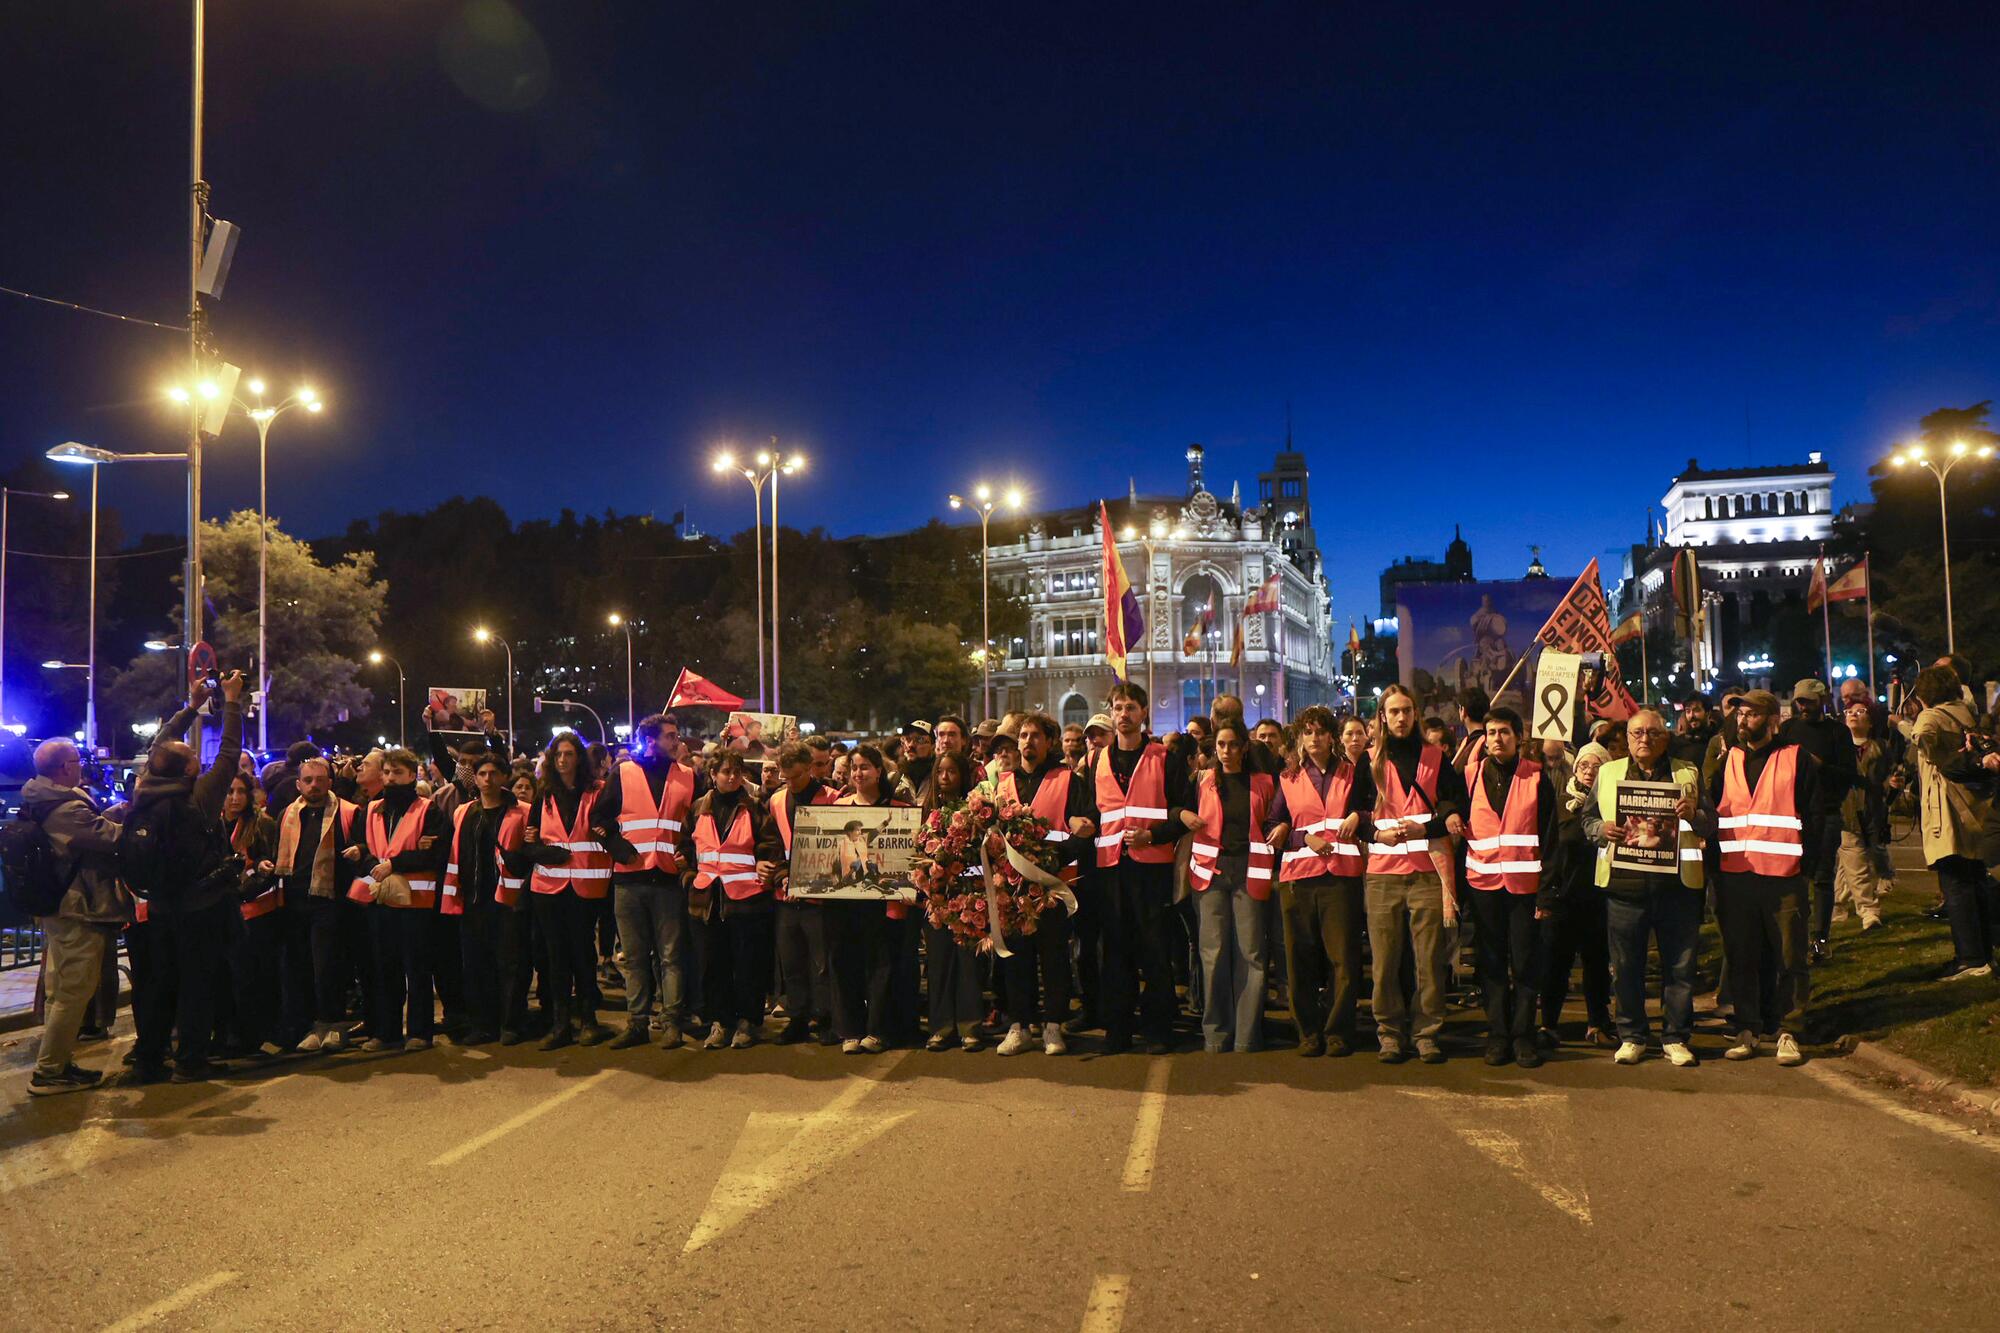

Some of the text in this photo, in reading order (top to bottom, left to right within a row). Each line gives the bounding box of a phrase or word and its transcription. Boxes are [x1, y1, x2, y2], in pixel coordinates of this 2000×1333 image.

[1619, 795, 1677, 809] MARICARMEN
[816, 837, 838, 849] VIDA
[878, 837, 913, 849] BARRIO
[1617, 847, 1674, 860] GRACIAS POR TODO
